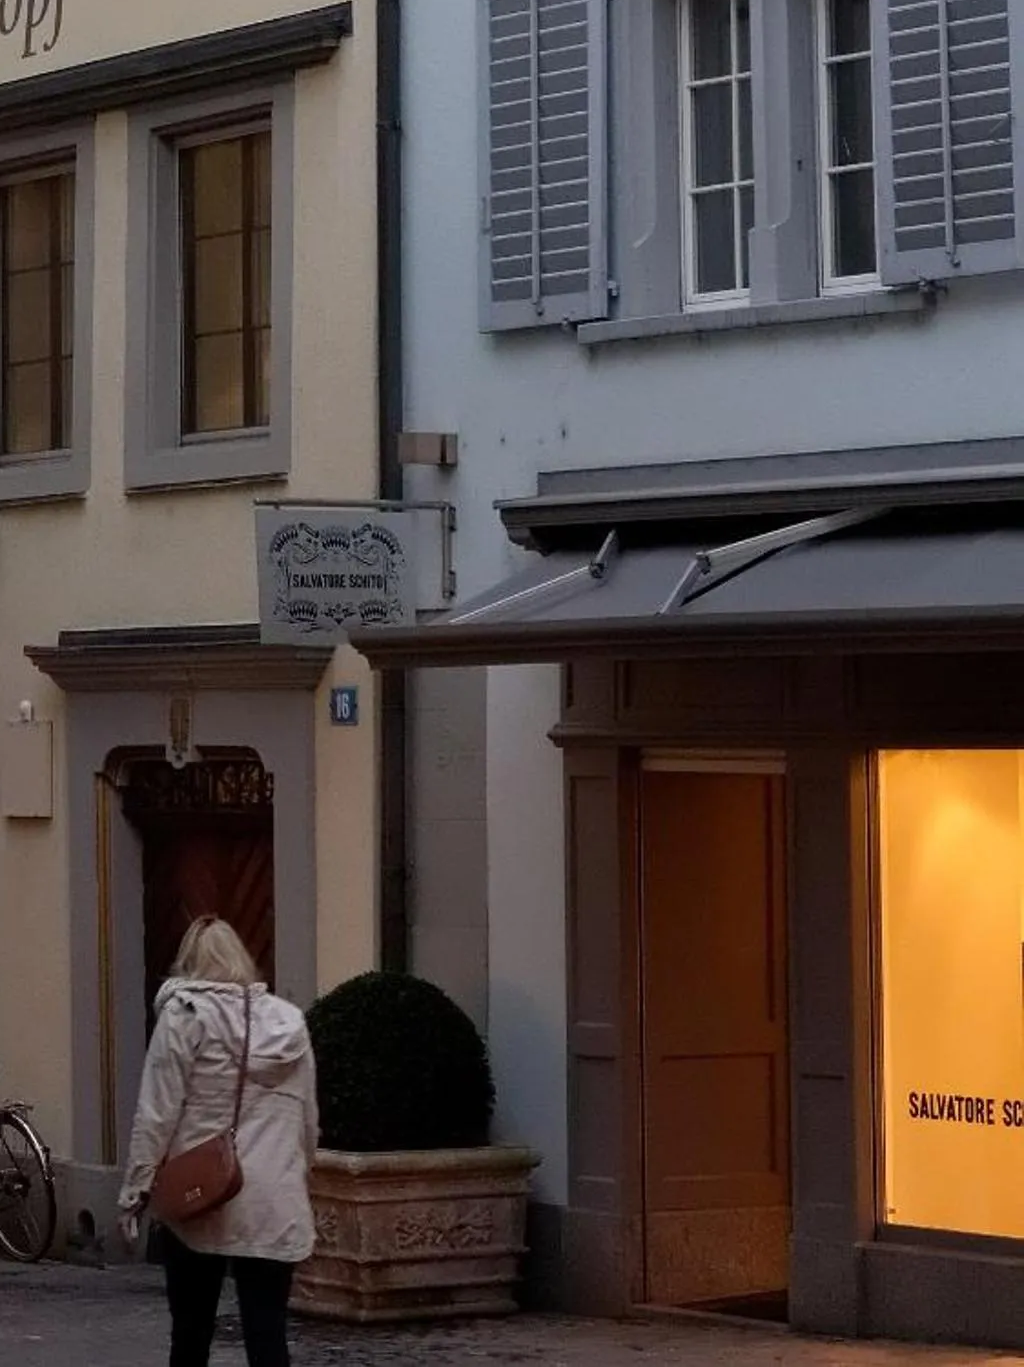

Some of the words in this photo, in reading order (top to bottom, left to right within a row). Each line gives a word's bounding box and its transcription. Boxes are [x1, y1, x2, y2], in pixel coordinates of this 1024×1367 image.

[292, 572, 347, 589] SALVATORE
[348, 572, 384, 589] SCHITO
[336, 693, 351, 719] 16
[908, 1091, 996, 1126] SALVATORE
[1002, 1099, 1024, 1127] SC
